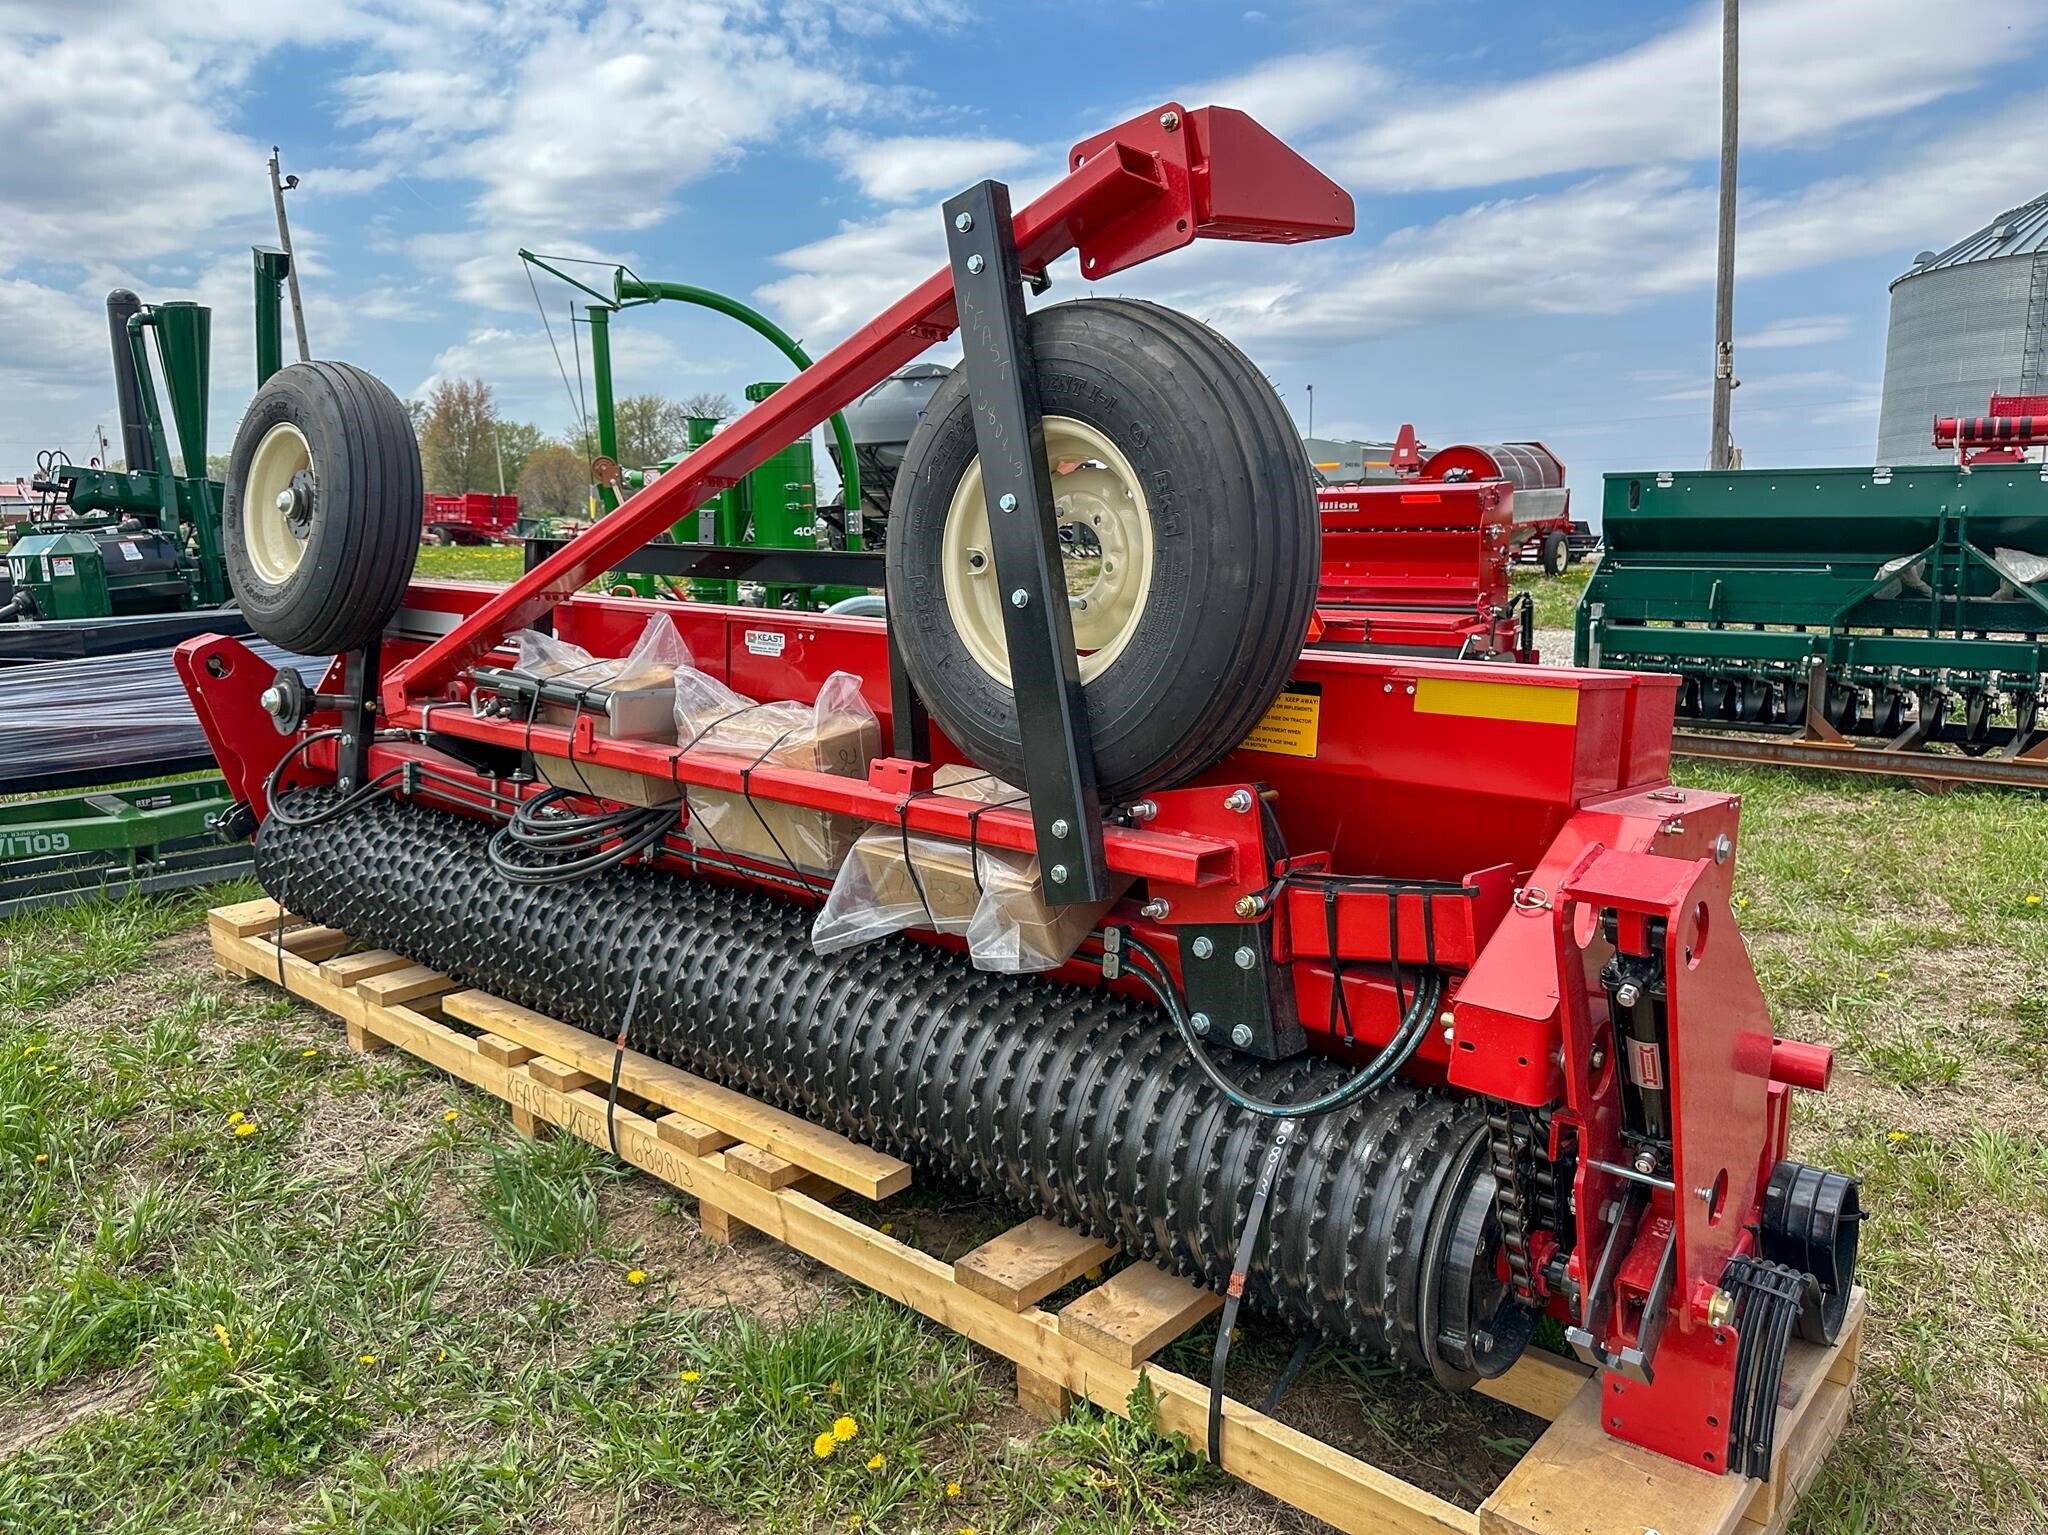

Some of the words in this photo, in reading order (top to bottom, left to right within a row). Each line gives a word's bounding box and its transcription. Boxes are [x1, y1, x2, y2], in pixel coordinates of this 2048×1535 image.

[1320, 501, 1359, 510] illion
[758, 633, 783, 643] KEAST
[0, 832, 70, 858] GOLI
[507, 1074, 551, 1117] KEAST
[630, 1132, 695, 1189] 680813
